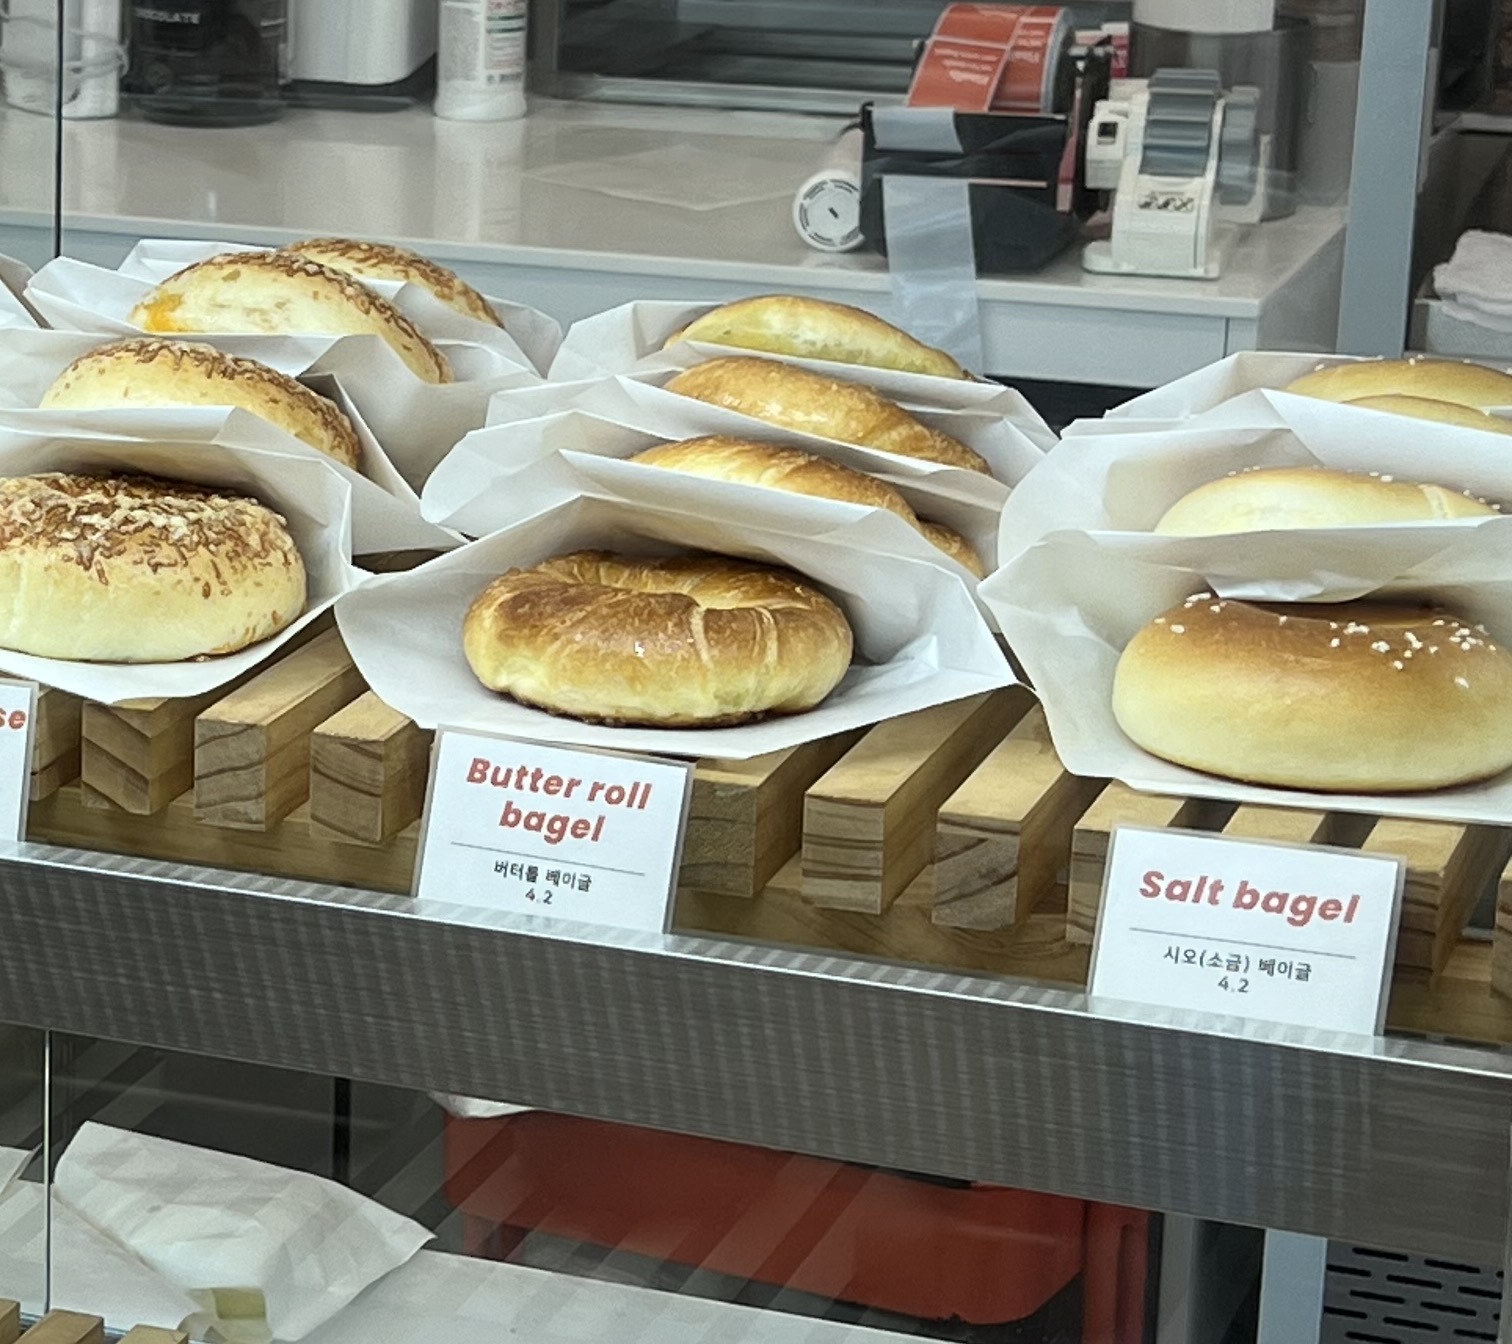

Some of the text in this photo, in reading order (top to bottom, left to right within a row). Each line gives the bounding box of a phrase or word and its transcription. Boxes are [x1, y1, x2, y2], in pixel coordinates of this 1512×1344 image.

[466, 757, 653, 810] Butter roll
[499, 800, 606, 845] bagel
[494, 860, 592, 892] 버터롤 베이글
[525, 888, 553, 905] 4.2
[1139, 870, 1360, 927] Salt bagel
[1163, 945, 1312, 982] 시오(소금) 베이글
[1218, 976, 1249, 993] 4.2
